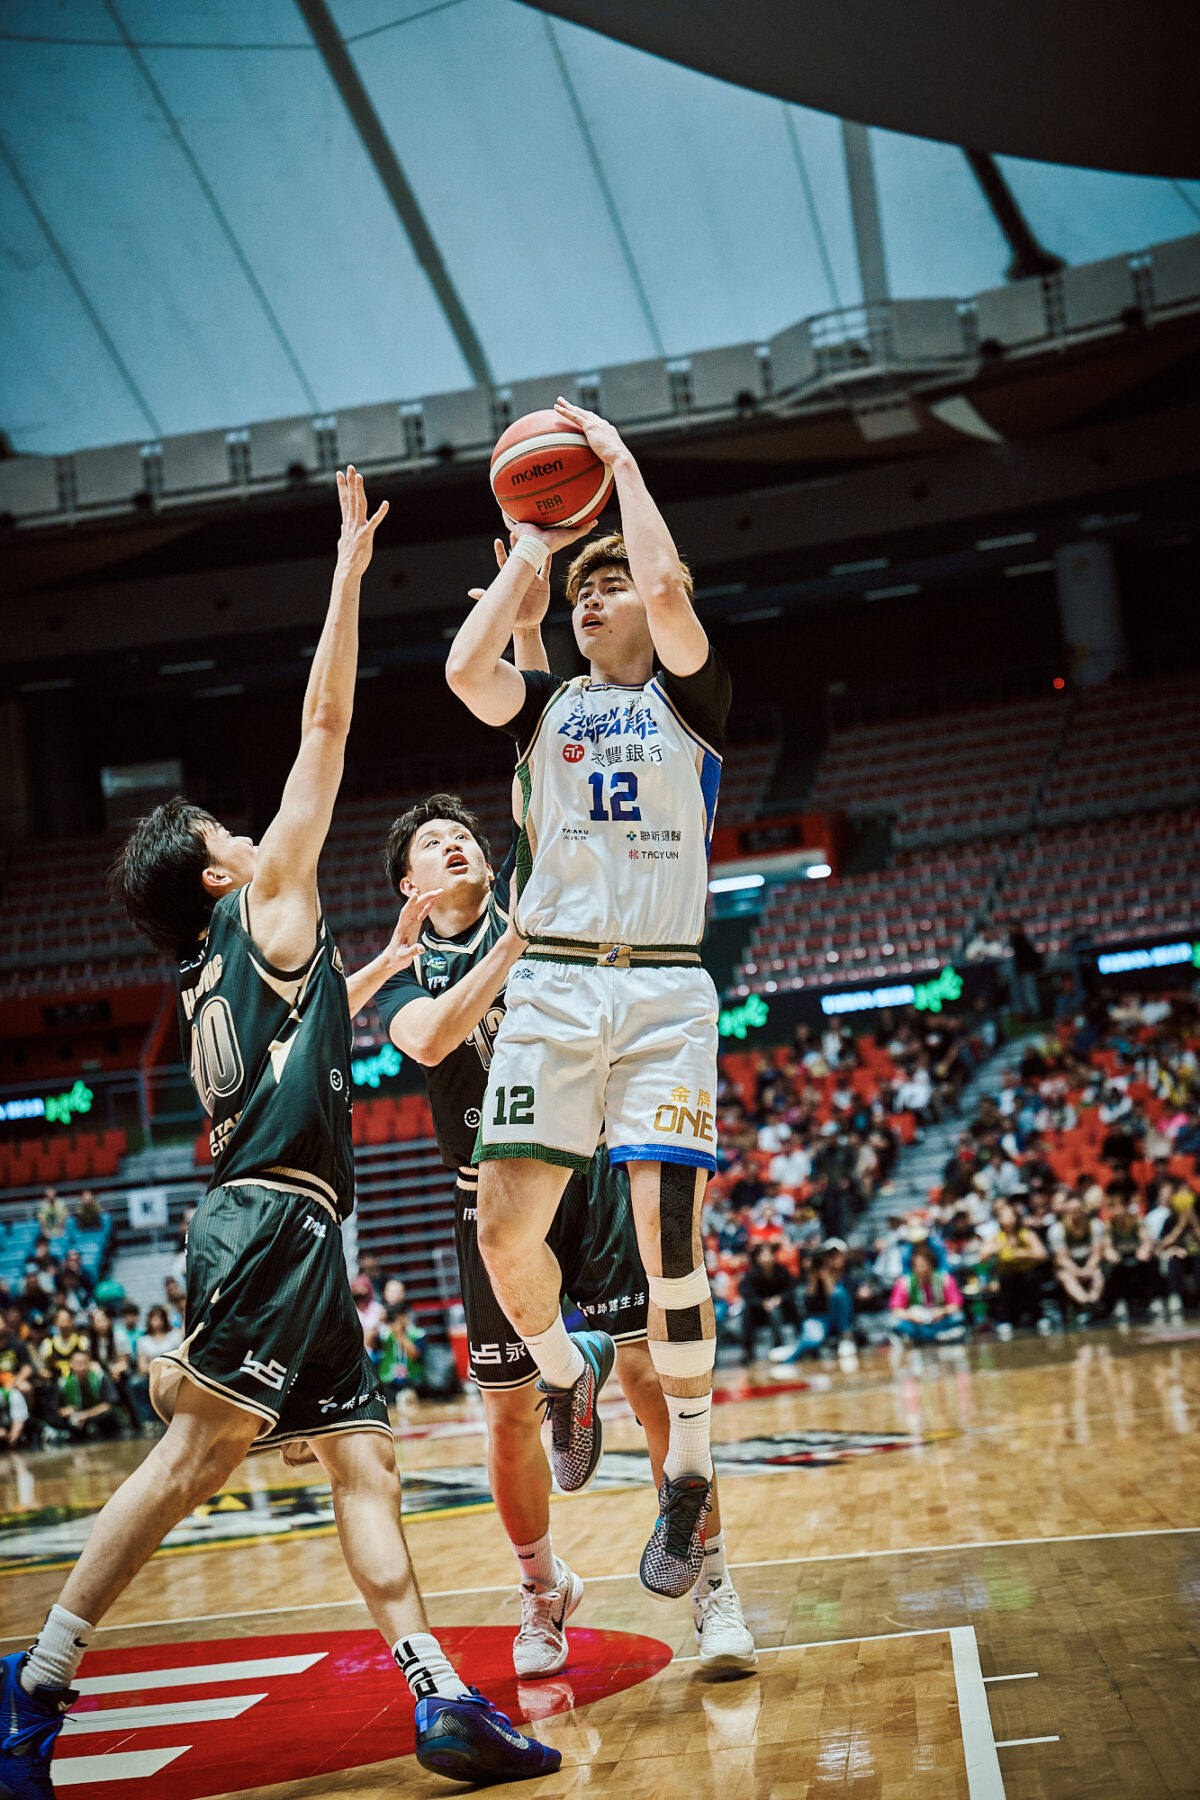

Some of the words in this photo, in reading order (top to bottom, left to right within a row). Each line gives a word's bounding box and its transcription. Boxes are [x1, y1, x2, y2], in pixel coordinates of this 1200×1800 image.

[511, 460, 563, 486] molten
[536, 494, 563, 512] FIBA
[588, 771, 642, 822] 12
[492, 1085, 535, 1126] 12
[671, 1085, 711, 1109] 金牌
[653, 1104, 714, 1143] ONE
